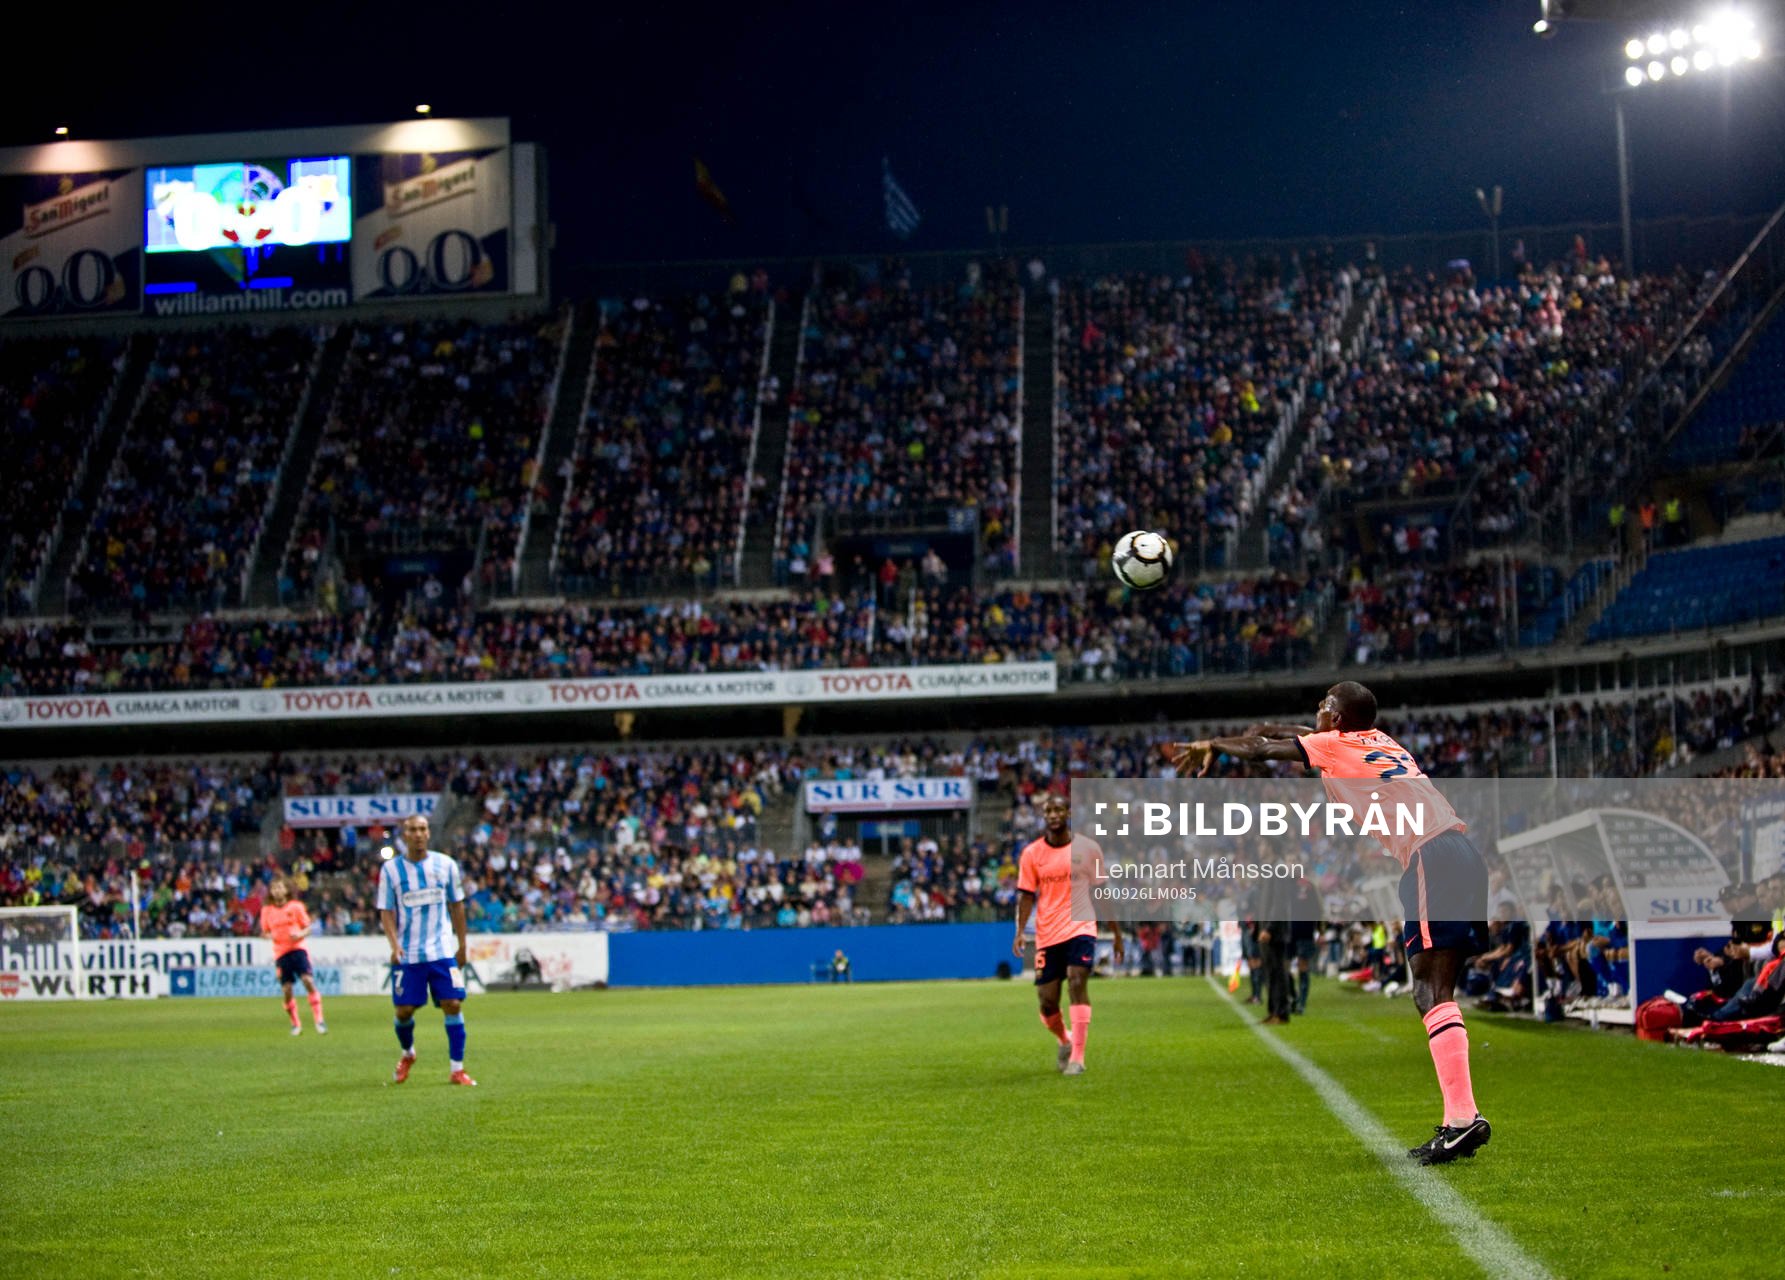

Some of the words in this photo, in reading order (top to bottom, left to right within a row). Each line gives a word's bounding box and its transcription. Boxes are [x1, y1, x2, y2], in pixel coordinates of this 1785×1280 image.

[154, 287, 347, 316] williamhill.com
[547, 682, 640, 702] TOYOTA
[644, 683, 712, 697] CUMACA
[716, 681, 776, 695] MOTOR
[820, 673, 912, 693] TOYOTA
[991, 670, 1050, 685] MOTOR
[24, 700, 111, 719] TOYOTA
[115, 700, 181, 714] CUMACA
[184, 698, 240, 712] MOTOR
[281, 691, 373, 711] TOYOTA
[376, 691, 443, 706] CUMACA
[446, 690, 505, 705] MOTOR
[813, 783, 880, 800] SUR
[895, 781, 962, 798] SUR
[290, 800, 355, 816] SUR
[368, 797, 433, 814] SUR
[1650, 898, 1715, 916] SUR
